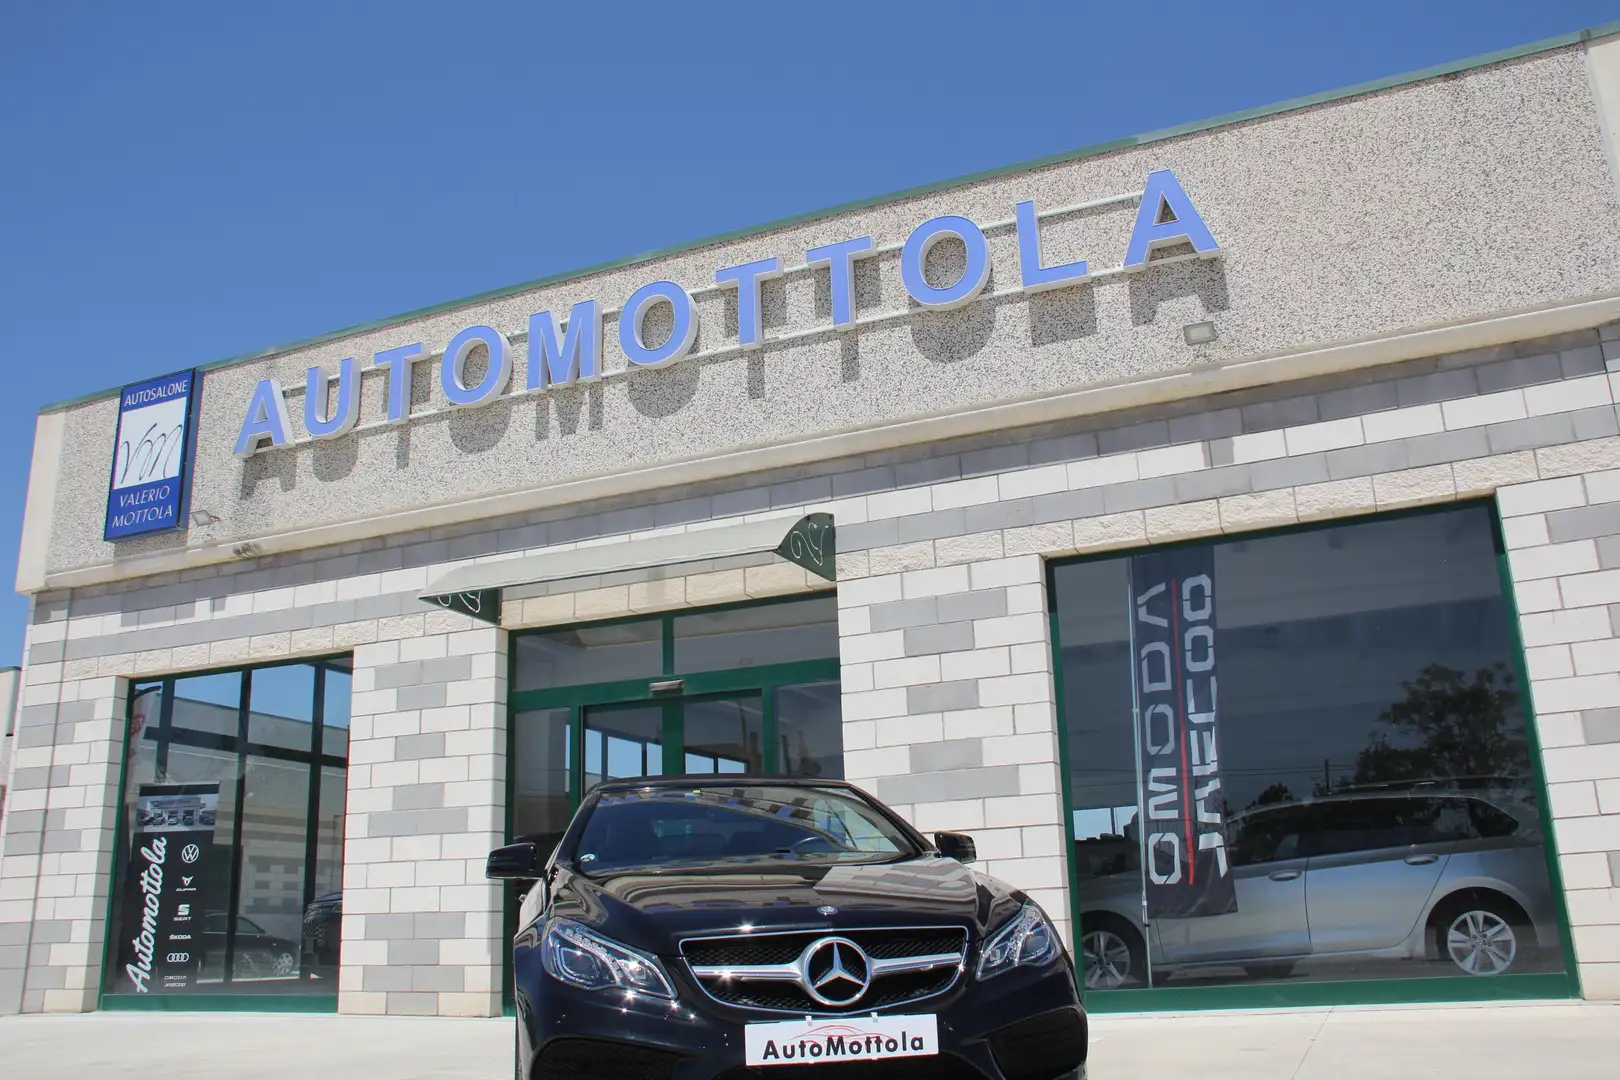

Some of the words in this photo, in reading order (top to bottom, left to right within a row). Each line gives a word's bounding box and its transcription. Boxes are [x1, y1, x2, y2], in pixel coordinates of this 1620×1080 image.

[233, 169, 1221, 456] AUTOMOTTOLA
[124, 380, 188, 407] AUTOSALONE
[112, 505, 172, 528] MOTTOLA
[119, 485, 170, 508] VALERIO
[1137, 581, 1182, 885] OMODA
[1182, 573, 1229, 879] JAECOO
[126, 836, 167, 993] Automottola
[762, 1031, 924, 1060] AutoMottola
